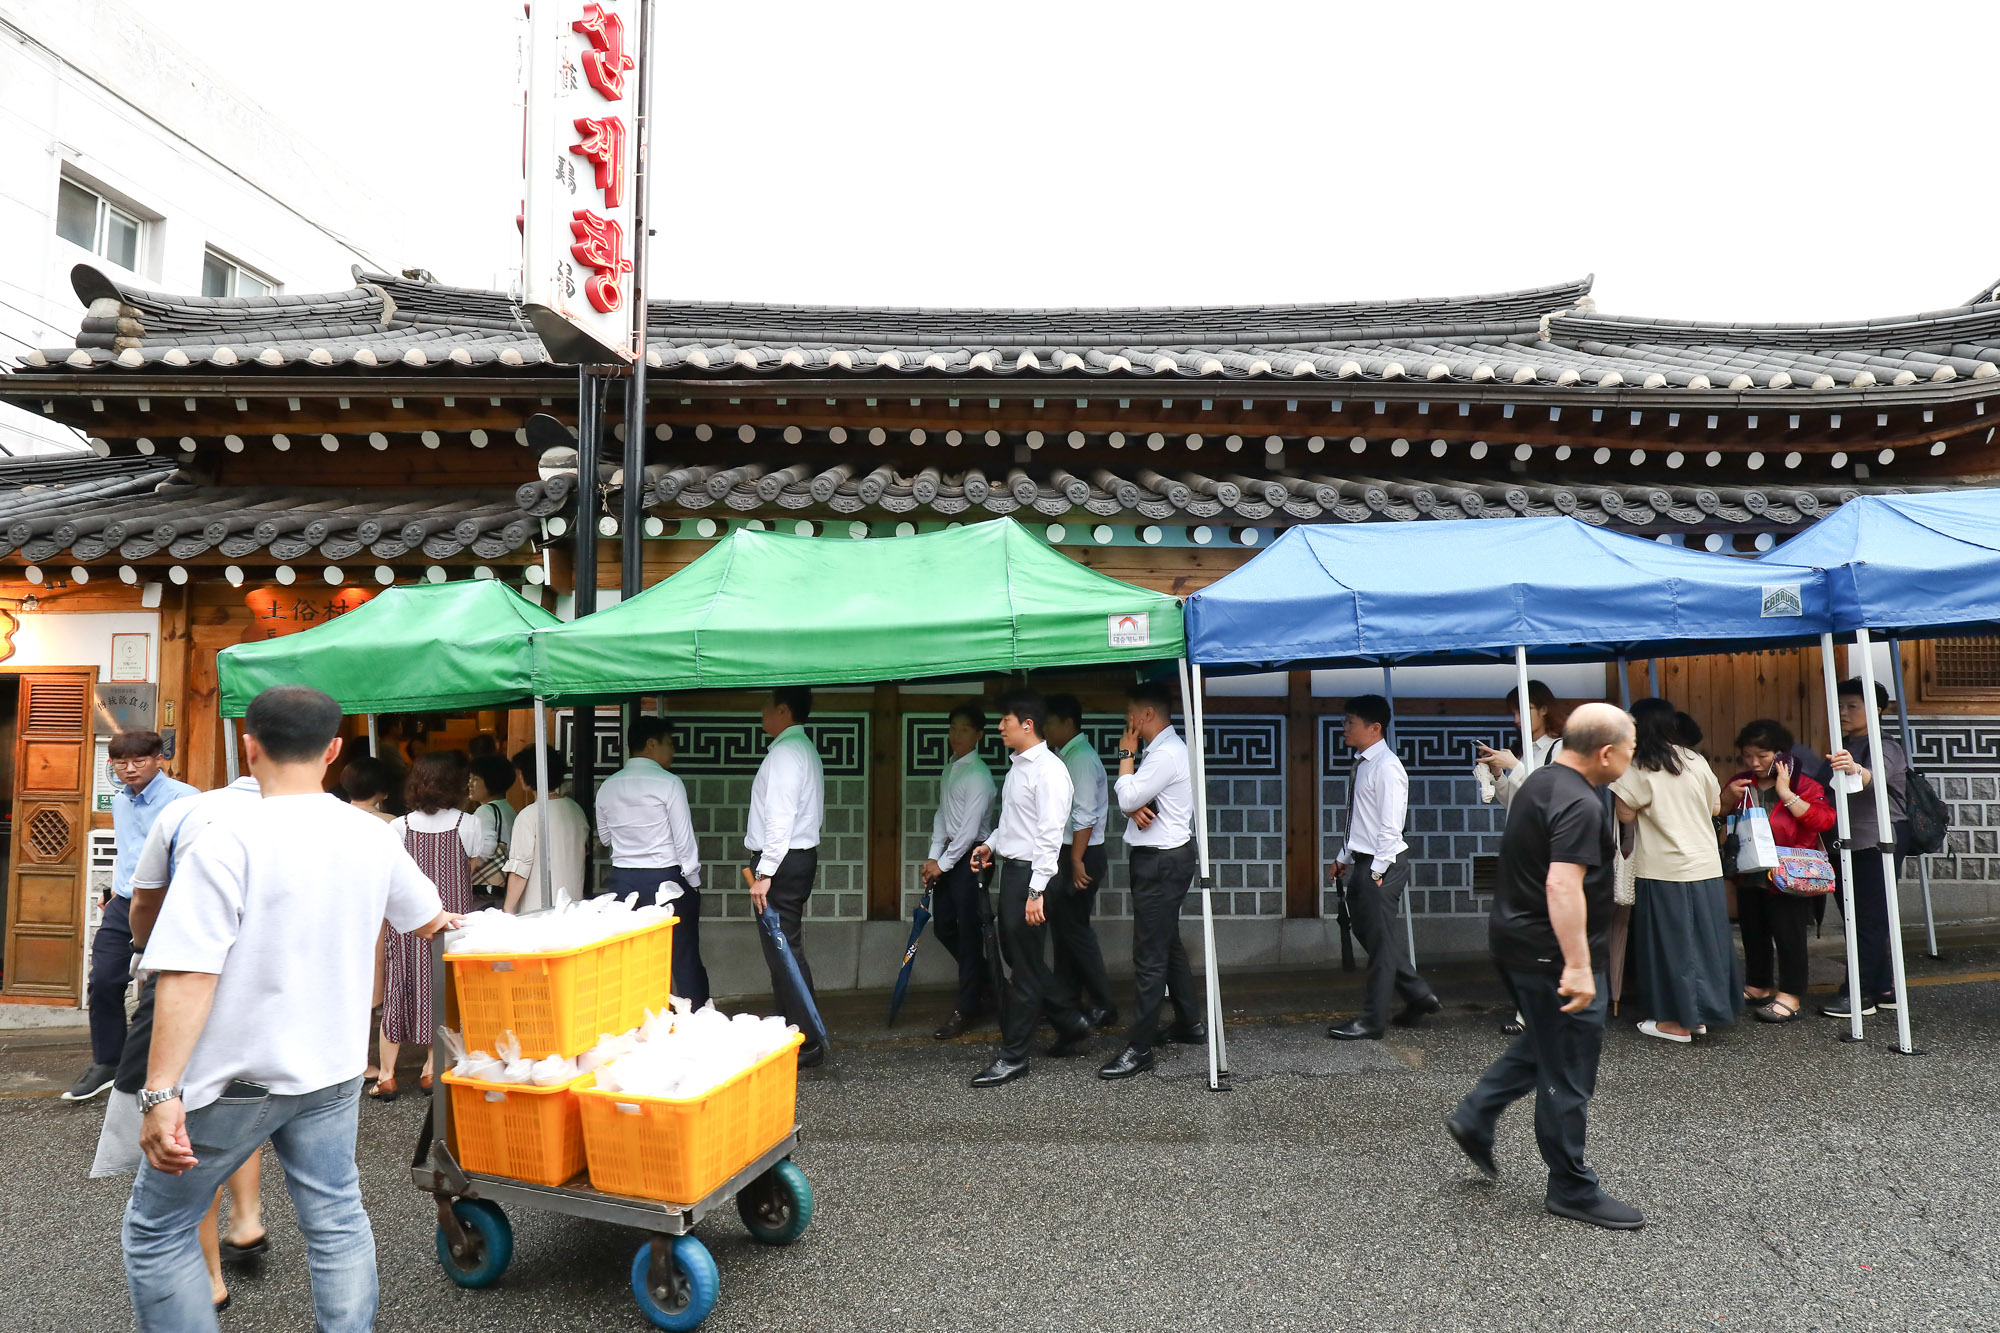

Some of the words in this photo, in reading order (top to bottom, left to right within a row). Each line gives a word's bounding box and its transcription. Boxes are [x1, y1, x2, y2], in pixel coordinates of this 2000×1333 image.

[570, 2, 635, 314] 삼계탕
[261, 598, 367, 621] 土俗村
[1764, 591, 1800, 611] CARAVAN
